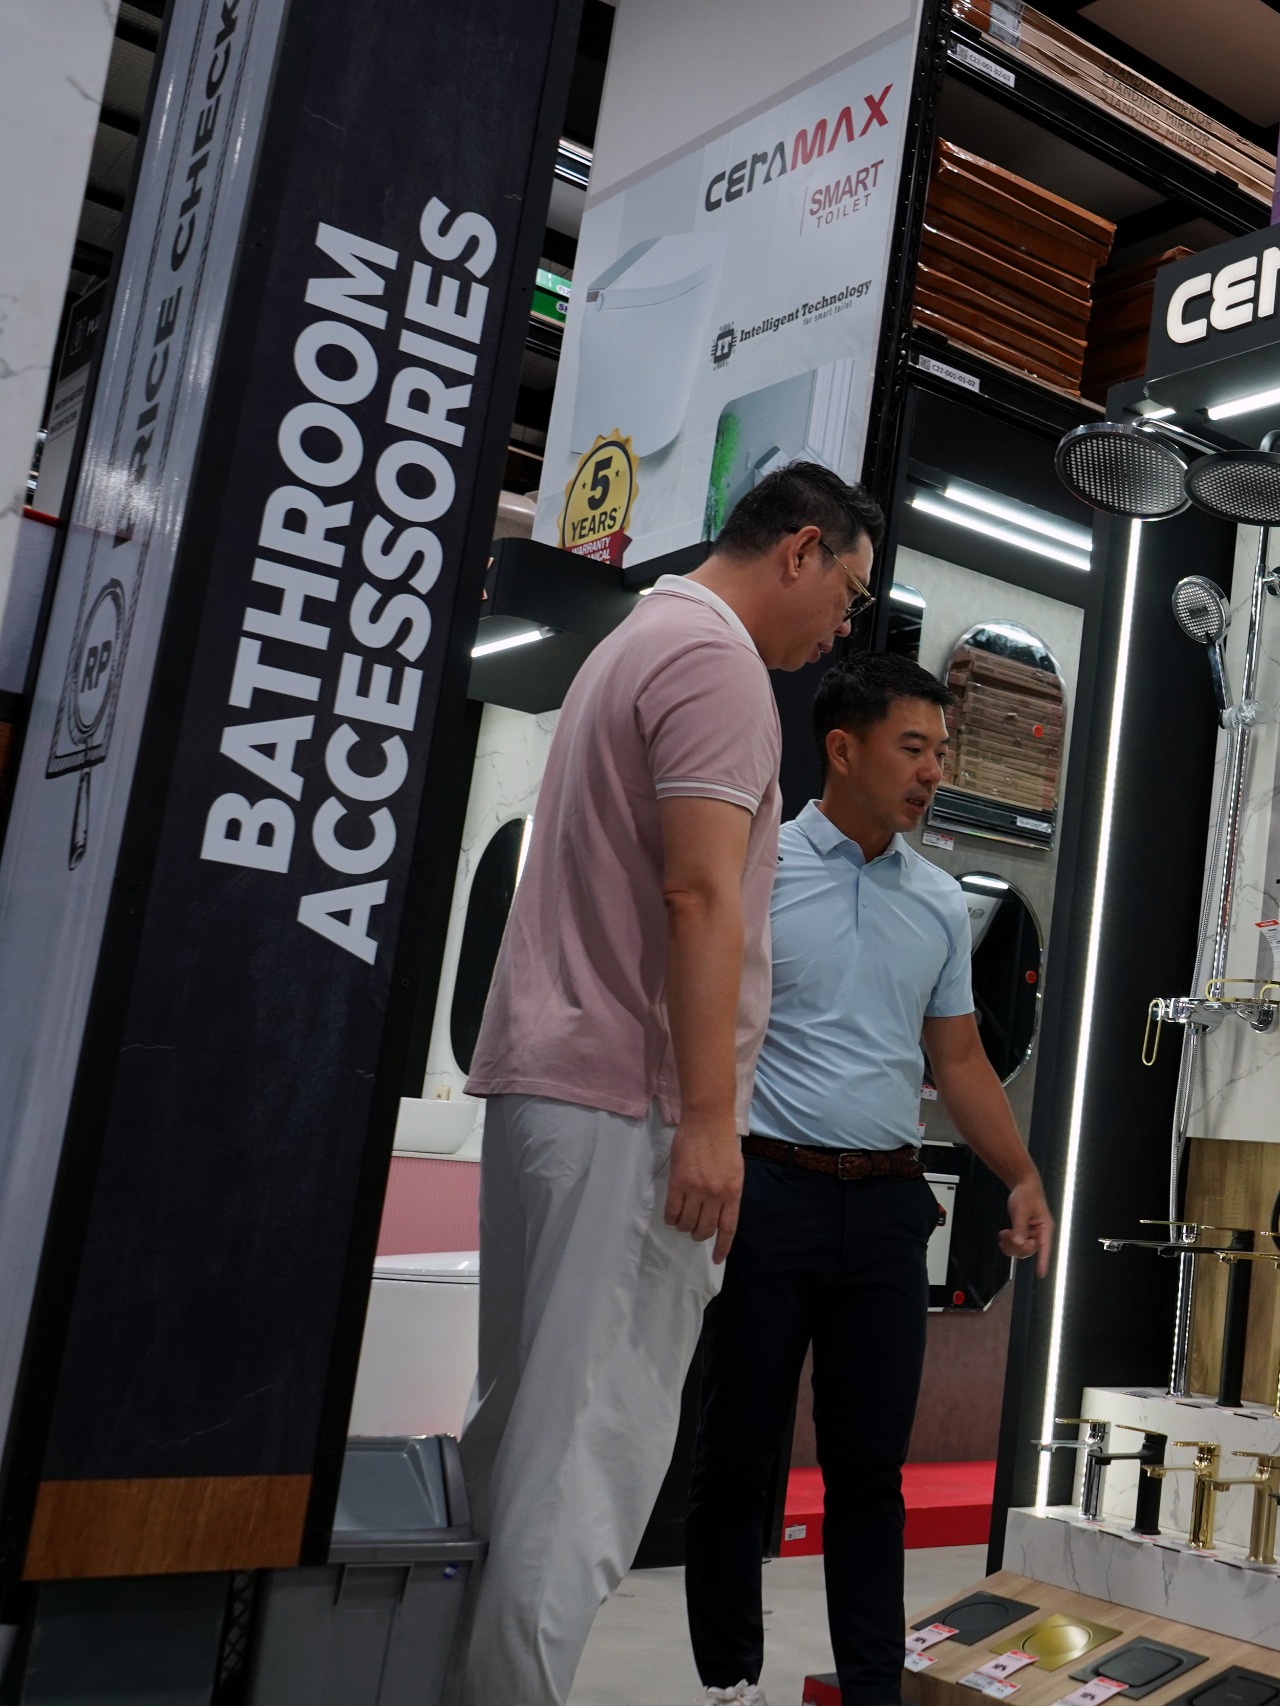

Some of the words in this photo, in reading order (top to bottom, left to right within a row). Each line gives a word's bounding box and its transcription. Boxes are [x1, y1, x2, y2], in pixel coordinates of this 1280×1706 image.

[1101, 72, 1160, 115] STANDING
[1165, 111, 1211, 146] MIRROR
[1103, 58, 1164, 100] STANDING
[1169, 99, 1213, 130] MIRROR
[171, 0, 240, 273] CHECK
[704, 83, 894, 212] CERAMAX
[1165, 128, 1211, 161] MIRROR
[809, 159, 884, 216] SMART
[816, 193, 872, 229] TOILET
[739, 307, 800, 342] Intelligent
[801, 279, 872, 317] Technology
[814, 308, 832, 322] smart
[834, 300, 853, 314] toilet
[715, 335, 732, 357] IT
[587, 455, 613, 511] 5
[200, 220, 400, 875] BATHROOM
[571, 507, 618, 542] YEARS
[296, 196, 499, 967] ACCESSORIES
[80, 639, 112, 694] RP
